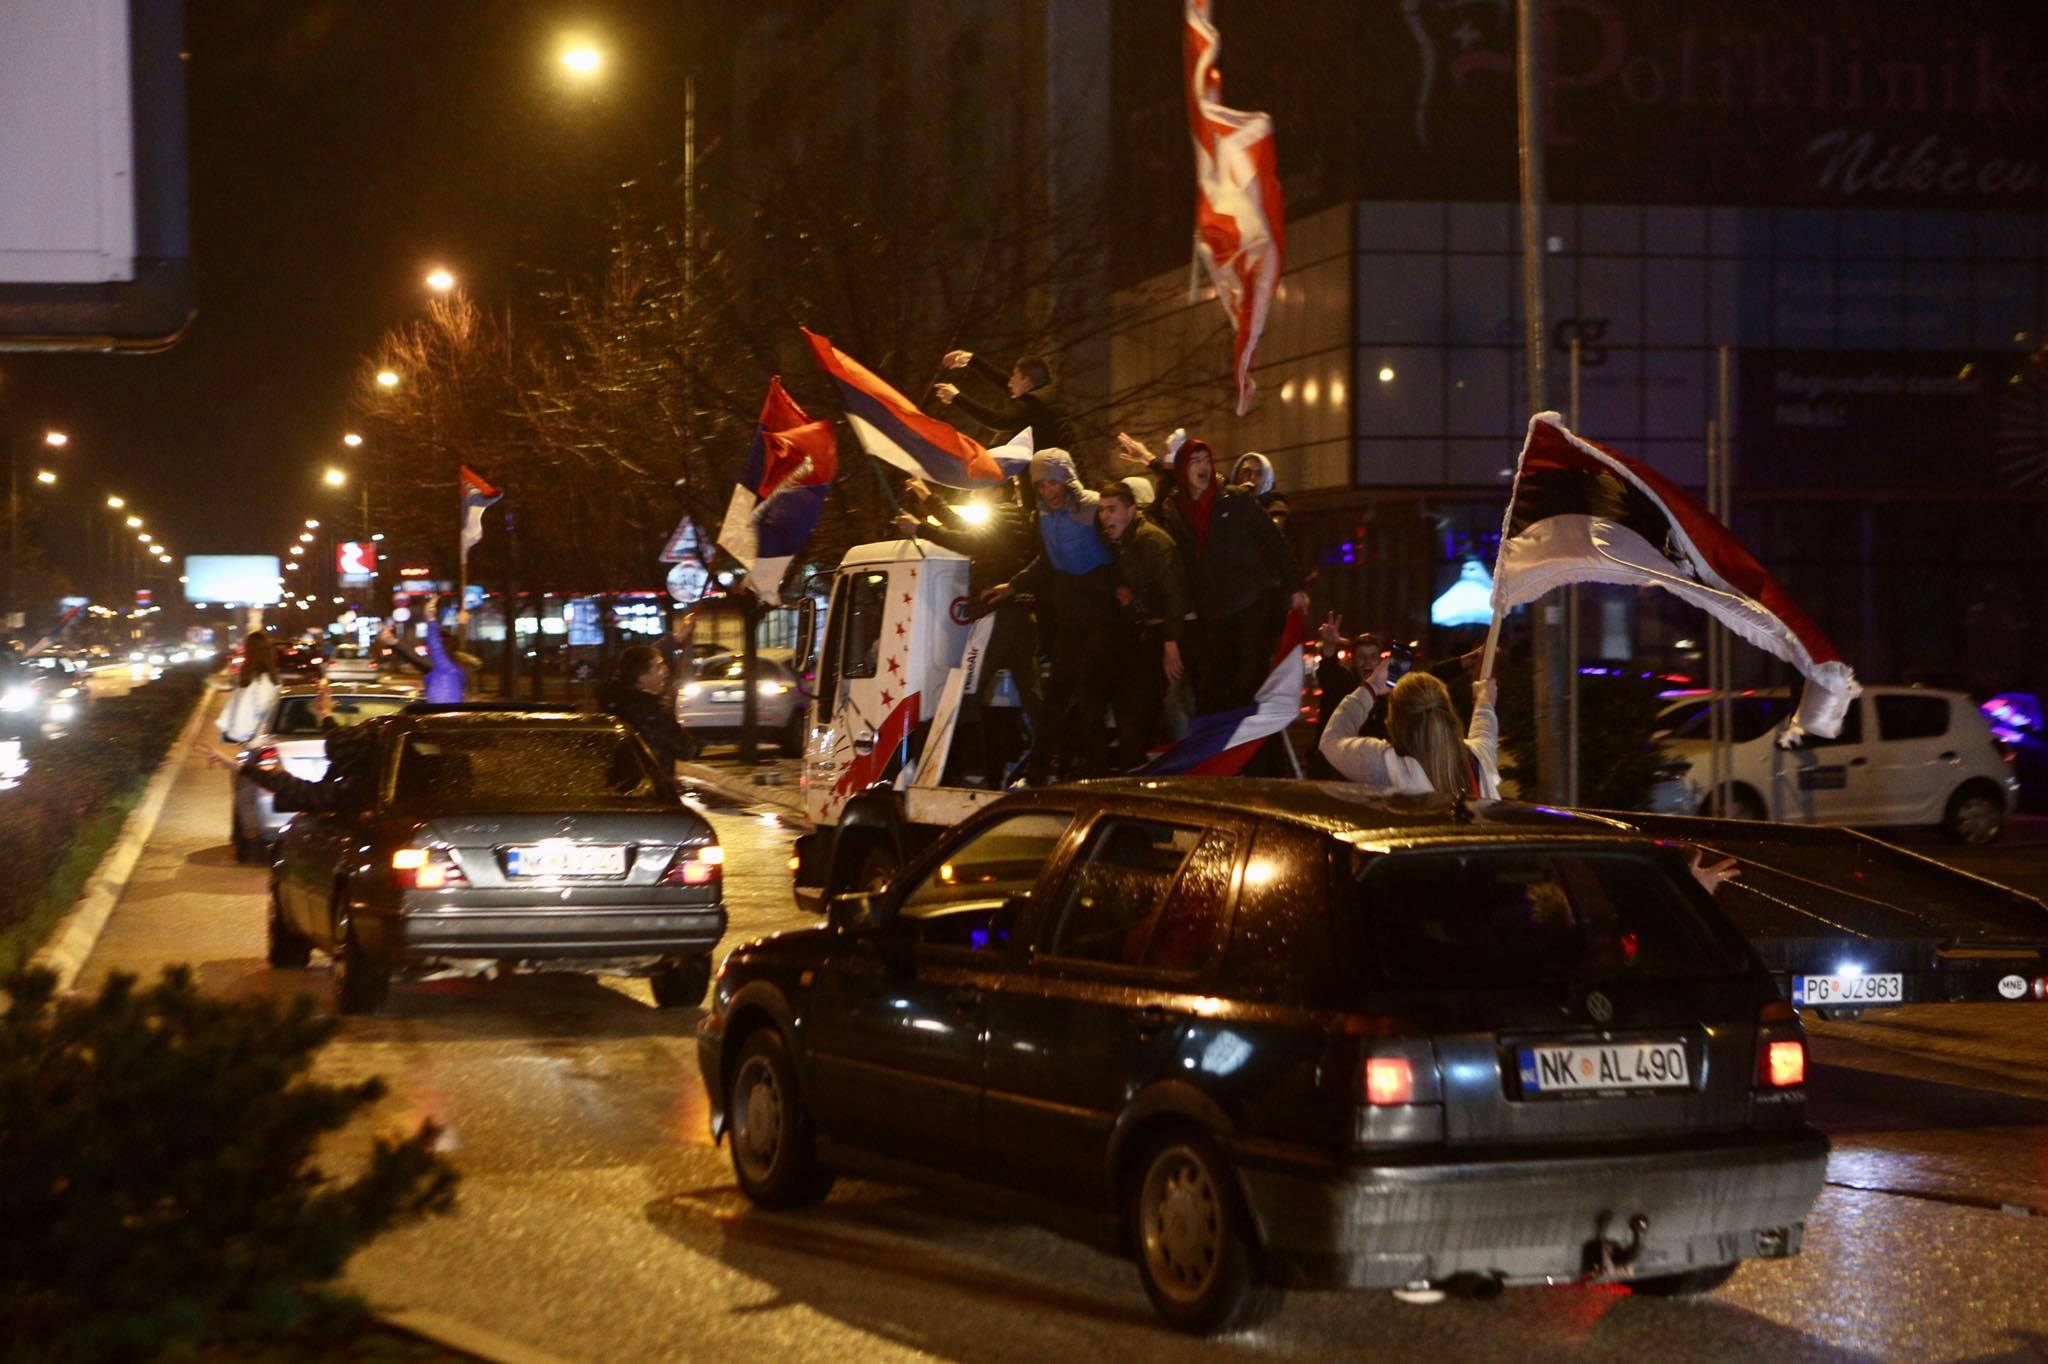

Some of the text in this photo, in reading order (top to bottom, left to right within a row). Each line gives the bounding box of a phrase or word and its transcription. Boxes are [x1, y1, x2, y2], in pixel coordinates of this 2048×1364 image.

[1807, 979, 1829, 1000] PG
[2002, 980, 2023, 990] MNE
[1540, 1051, 1578, 1085] NK
